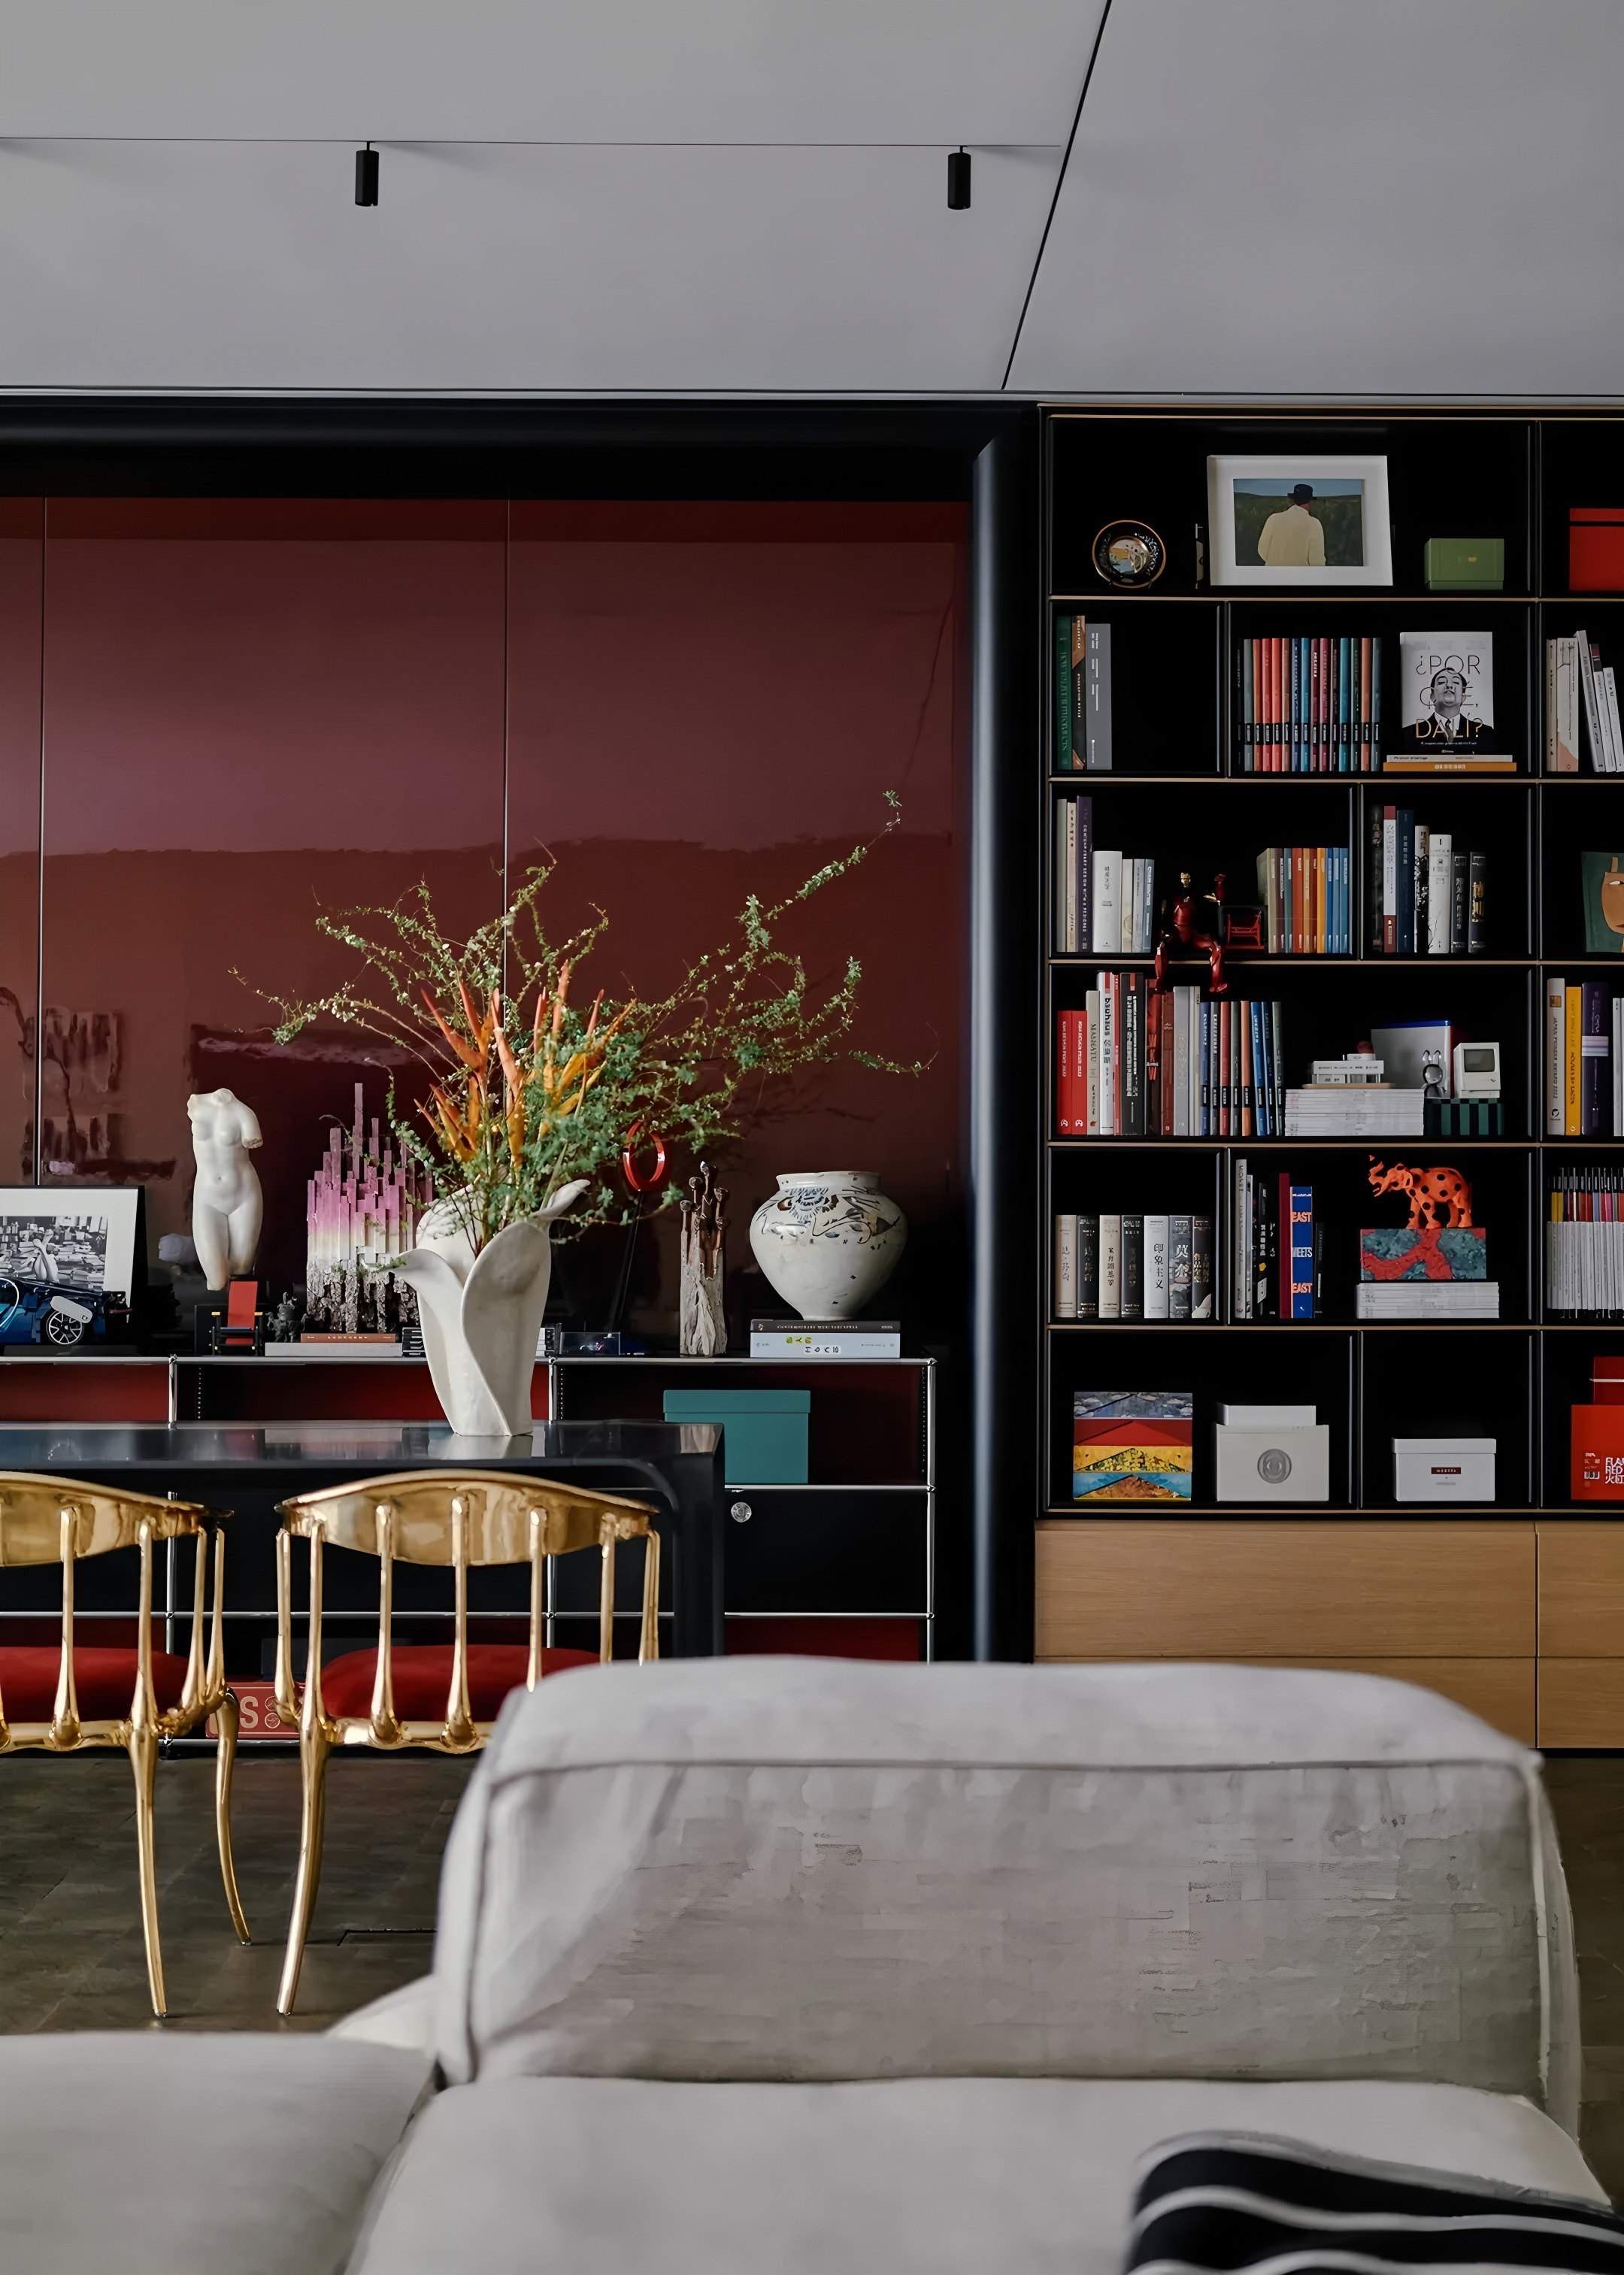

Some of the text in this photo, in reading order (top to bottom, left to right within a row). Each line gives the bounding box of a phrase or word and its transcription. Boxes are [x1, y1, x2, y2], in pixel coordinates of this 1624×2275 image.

[1416, 655, 1480, 675] ¿POR
[1416, 712, 1483, 738] DALÍ?
[1292, 1212, 1312, 1222] EAST
[1292, 1283, 1313, 1294] EAST
[239, 1695, 259, 1729] S
